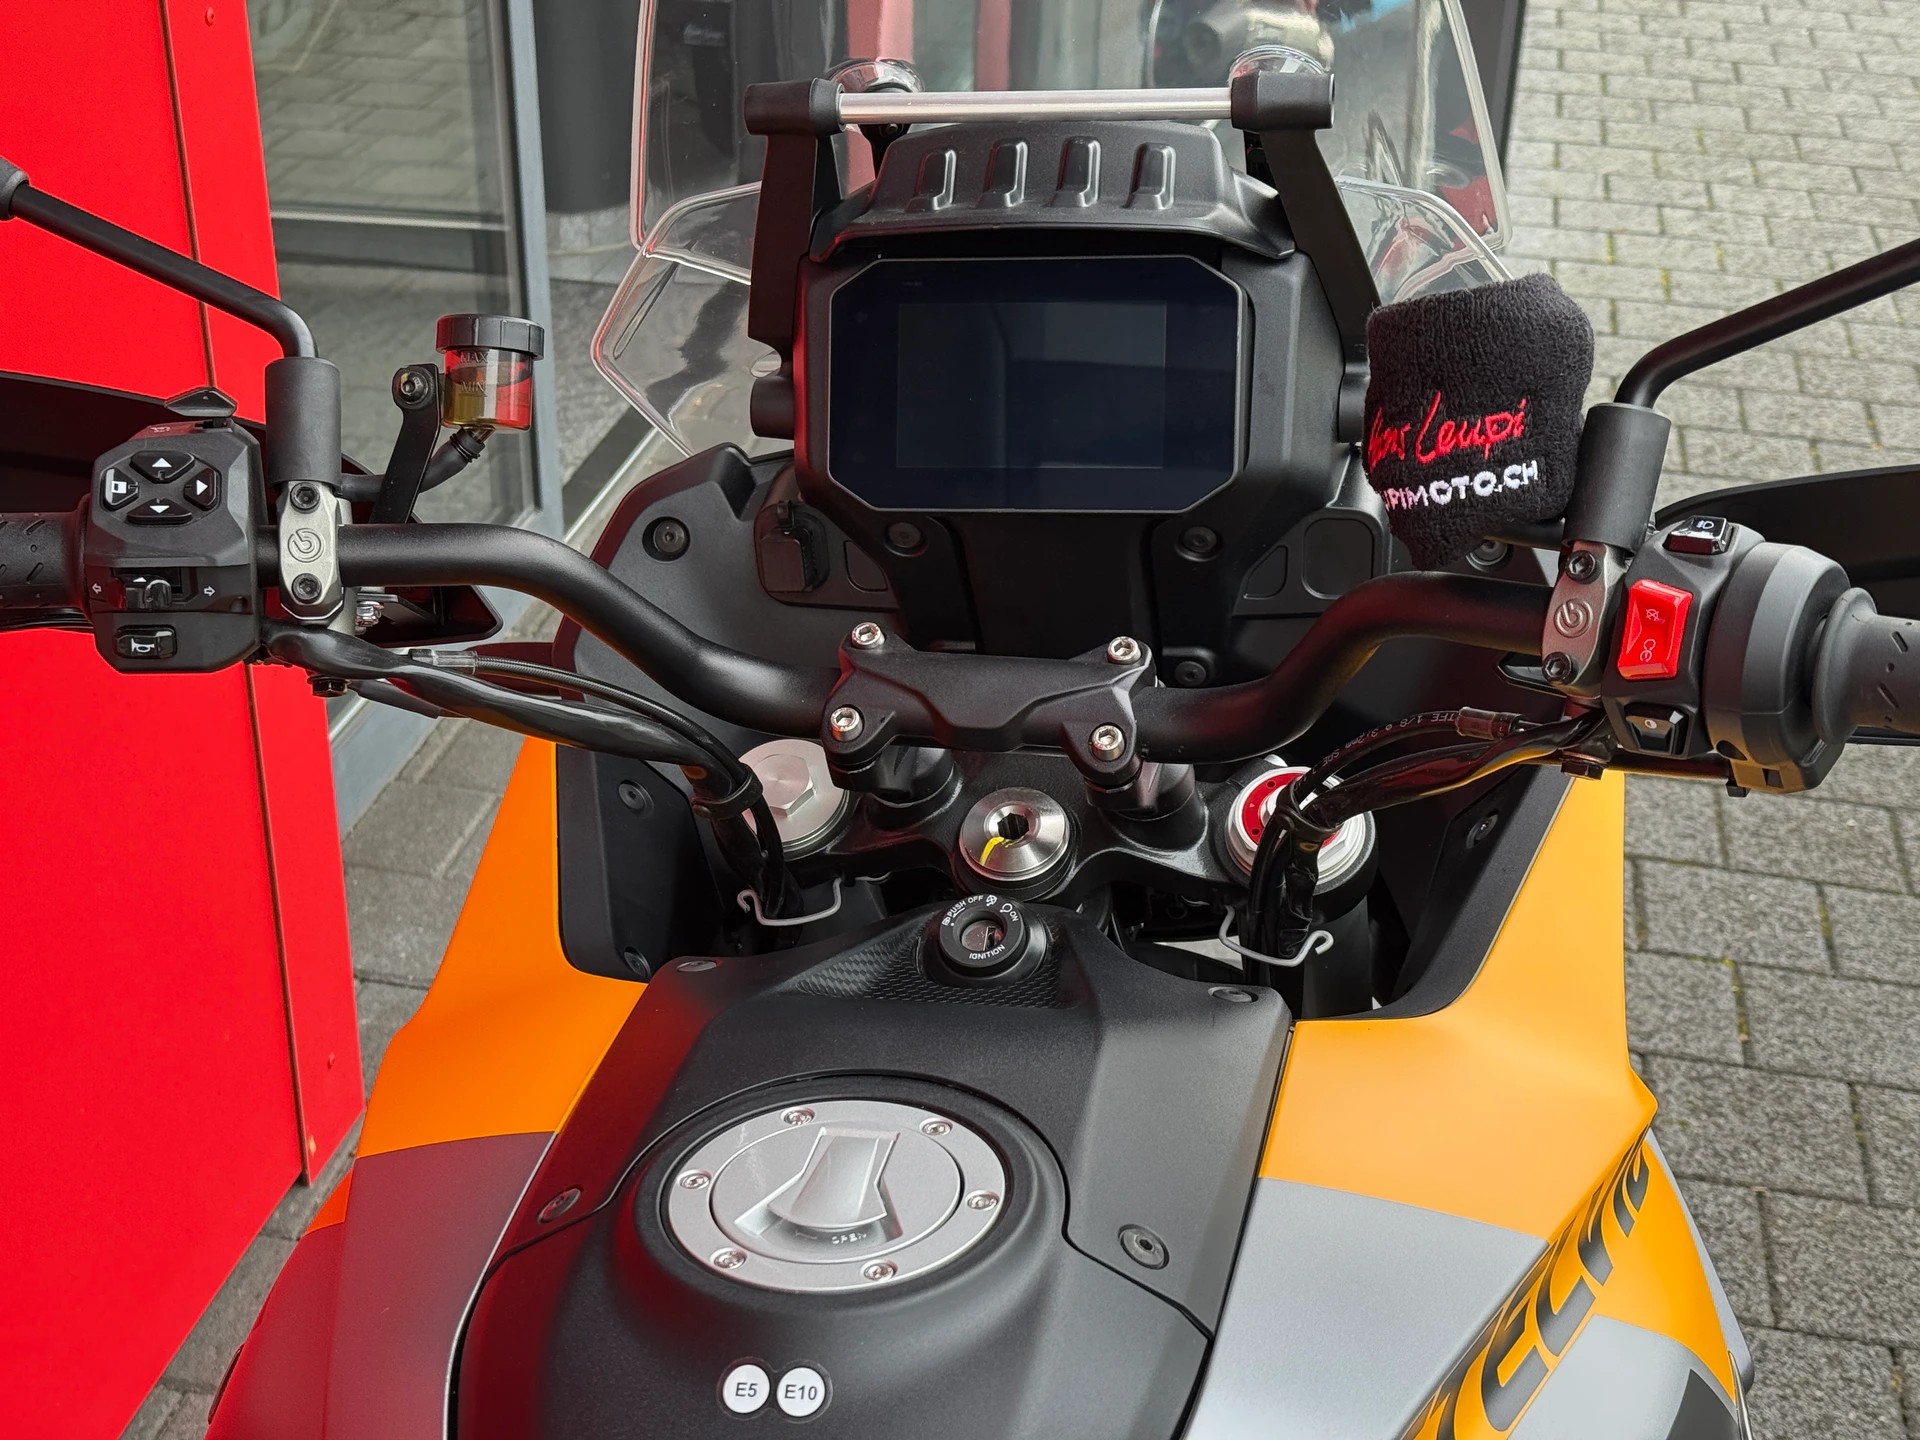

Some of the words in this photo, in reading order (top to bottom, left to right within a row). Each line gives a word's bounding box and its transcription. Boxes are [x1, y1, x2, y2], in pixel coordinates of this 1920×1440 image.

[460, 351, 488, 363] MAX
[461, 381, 486, 392] MIN
[947, 900, 966, 917] PUSH
[967, 895, 984, 904] OFF
[1009, 910, 1019, 922] ON
[968, 944, 1006, 960] IGNITION
[735, 1382, 758, 1398] E5
[784, 1384, 818, 1401] E10
